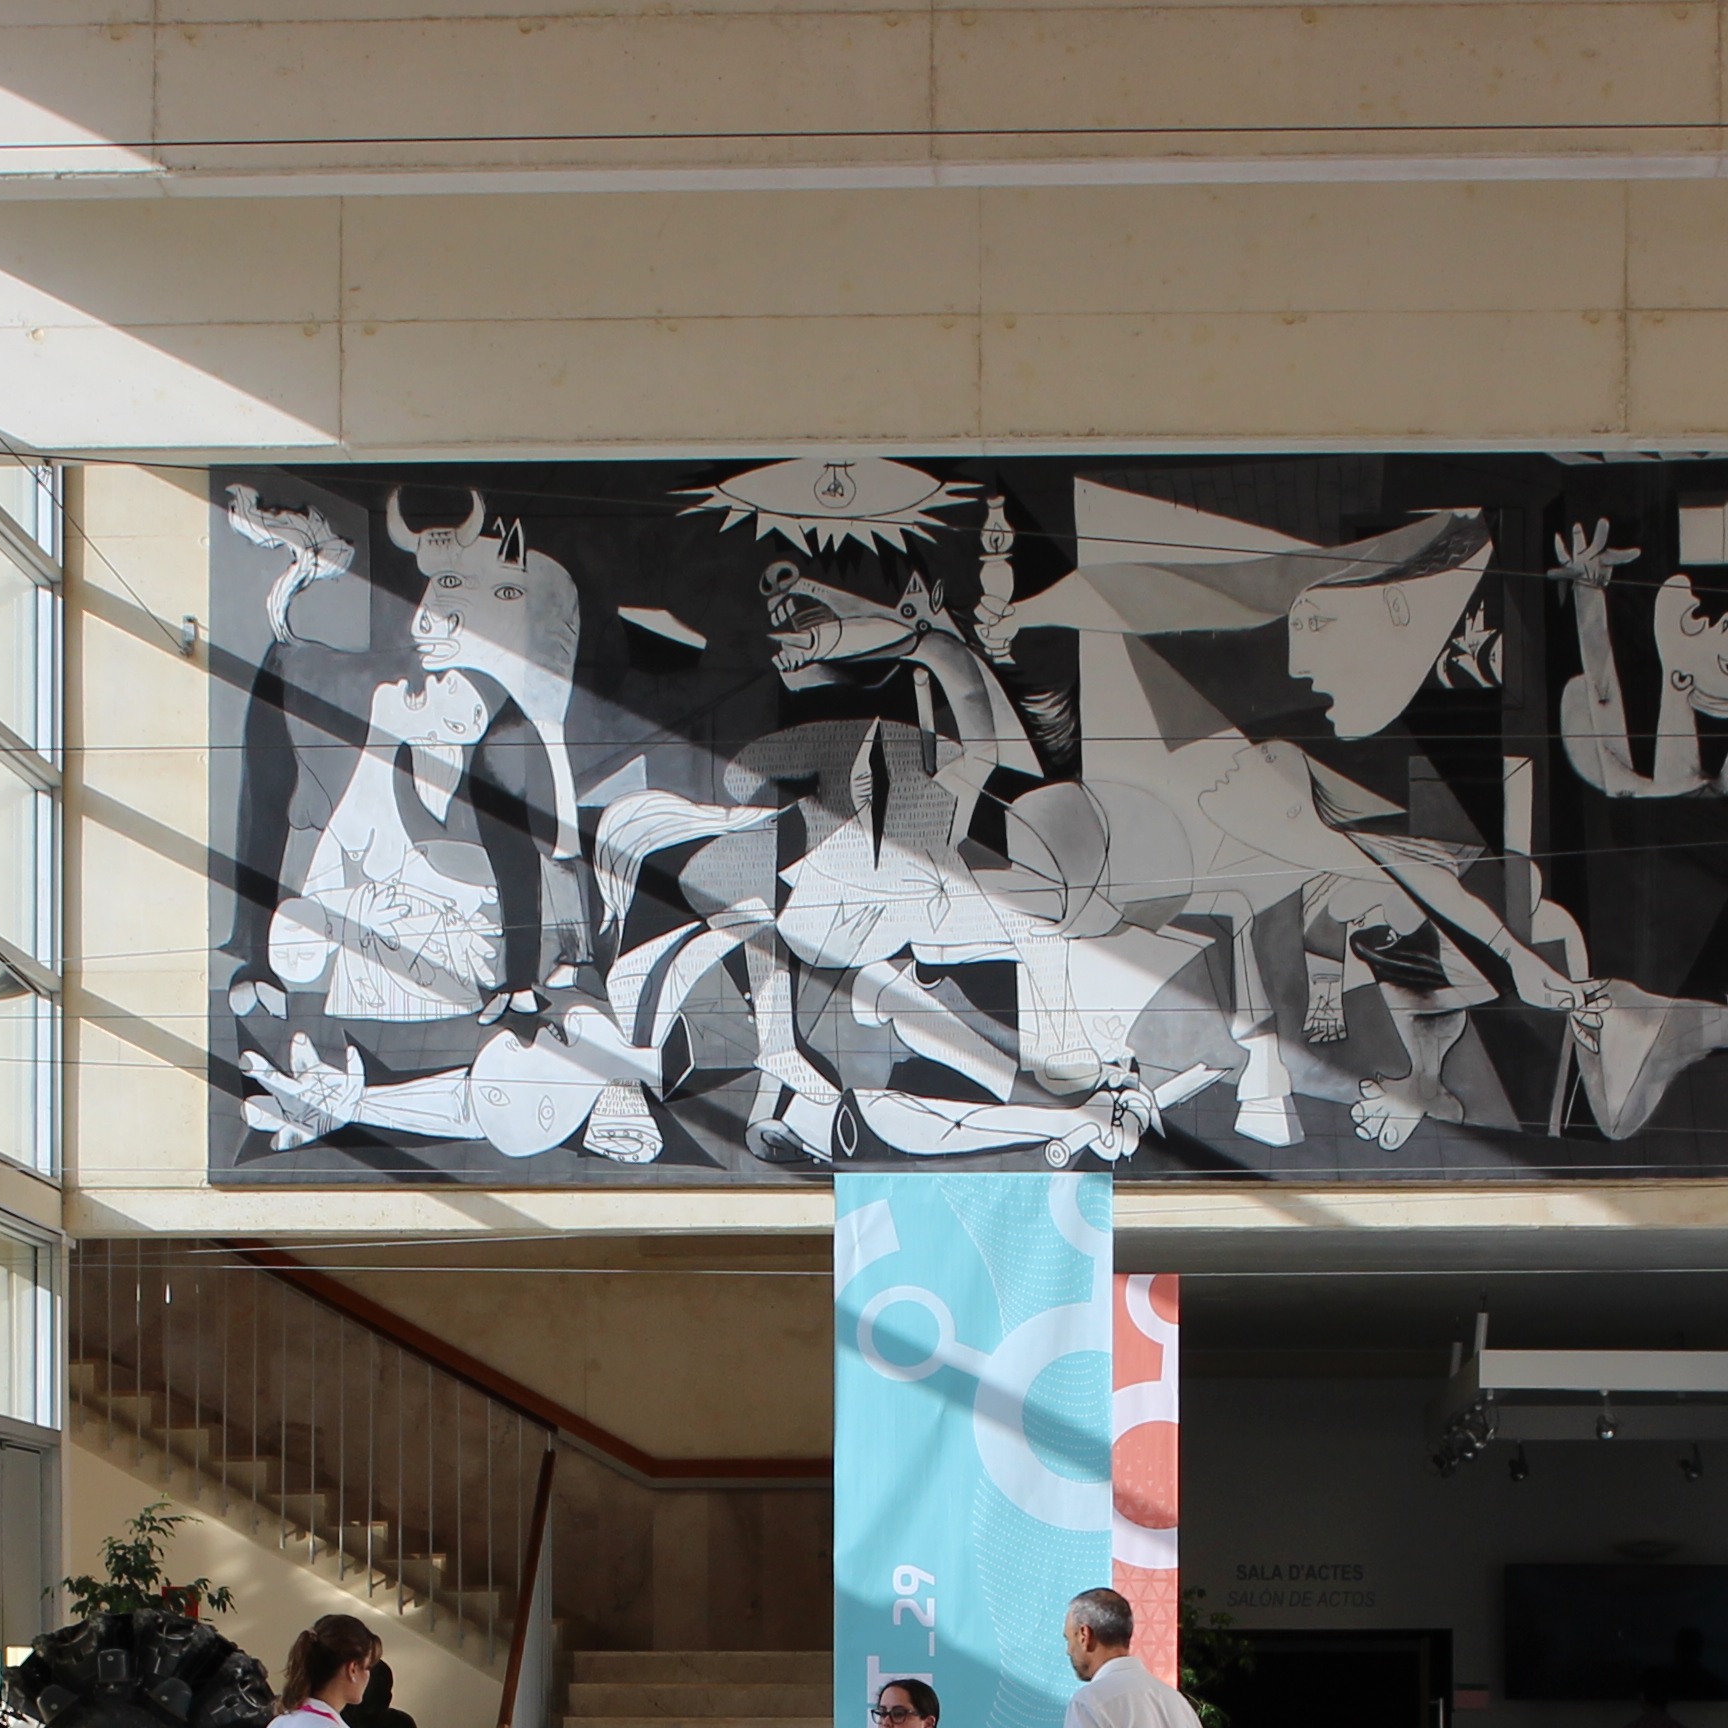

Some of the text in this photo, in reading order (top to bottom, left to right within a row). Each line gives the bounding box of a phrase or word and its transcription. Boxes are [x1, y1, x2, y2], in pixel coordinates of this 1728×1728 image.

[1236, 1564, 1364, 1581] SALA D'ACTES
[1226, 1588, 1376, 1608] SALÓN DE ACTOS
